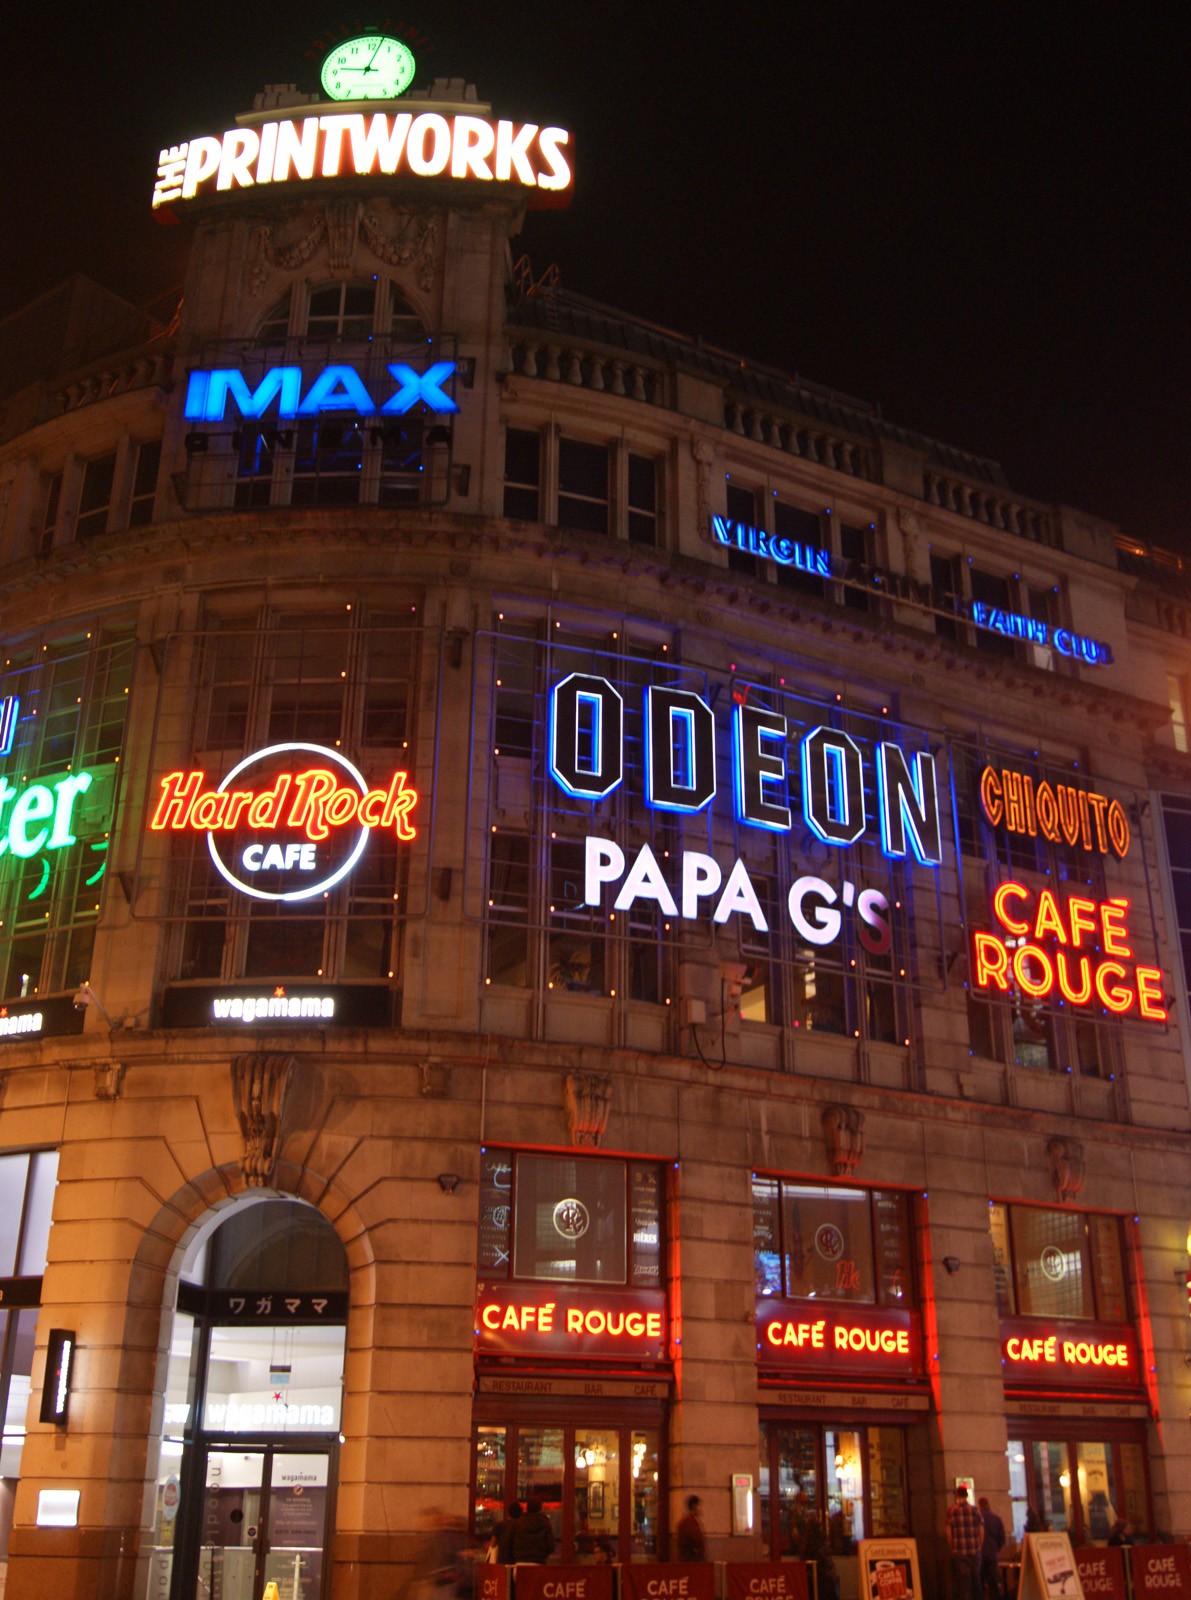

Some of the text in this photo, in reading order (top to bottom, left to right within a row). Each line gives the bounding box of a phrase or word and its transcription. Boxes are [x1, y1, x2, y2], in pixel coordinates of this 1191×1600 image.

[151, 113, 572, 209] THE PRINTWORKS
[184, 361, 461, 422] IMAX
[549, 672, 943, 867] ODEON
[151, 769, 418, 840] Hard Rock
[979, 764, 1131, 861] CHIQUITO
[241, 843, 317, 872] CAFE
[584, 835, 769, 933] PAPA
[993, 880, 1133, 958] CAFÉ
[974, 931, 1169, 1020] ROUGE
[213, 994, 335, 1023] wagamama
[229, 1295, 328, 1315] ワガママ
[482, 1303, 662, 1337] CAFÉ ROUGE
[767, 1320, 910, 1354] CAFÉ ROUGE
[1006, 1336, 1129, 1367] CAFÉ ROUGE
[492, 1380, 553, 1392] RESTAURANT
[584, 1383, 603, 1395] BAR
[778, 1393, 827, 1405] RESTAURANT
[851, 1396, 868, 1407] BAR
[281, 1474, 318, 1483] wagamama
[1147, 1555, 1176, 1573] CAFÉ
[542, 1578, 587, 1599] CAFÉ
[646, 1576, 690, 1596] CAFÉ
[749, 1575, 787, 1594] CAFÉ
[1083, 1576, 1114, 1593] OUGE
[1144, 1573, 1182, 1589] ROUGE
